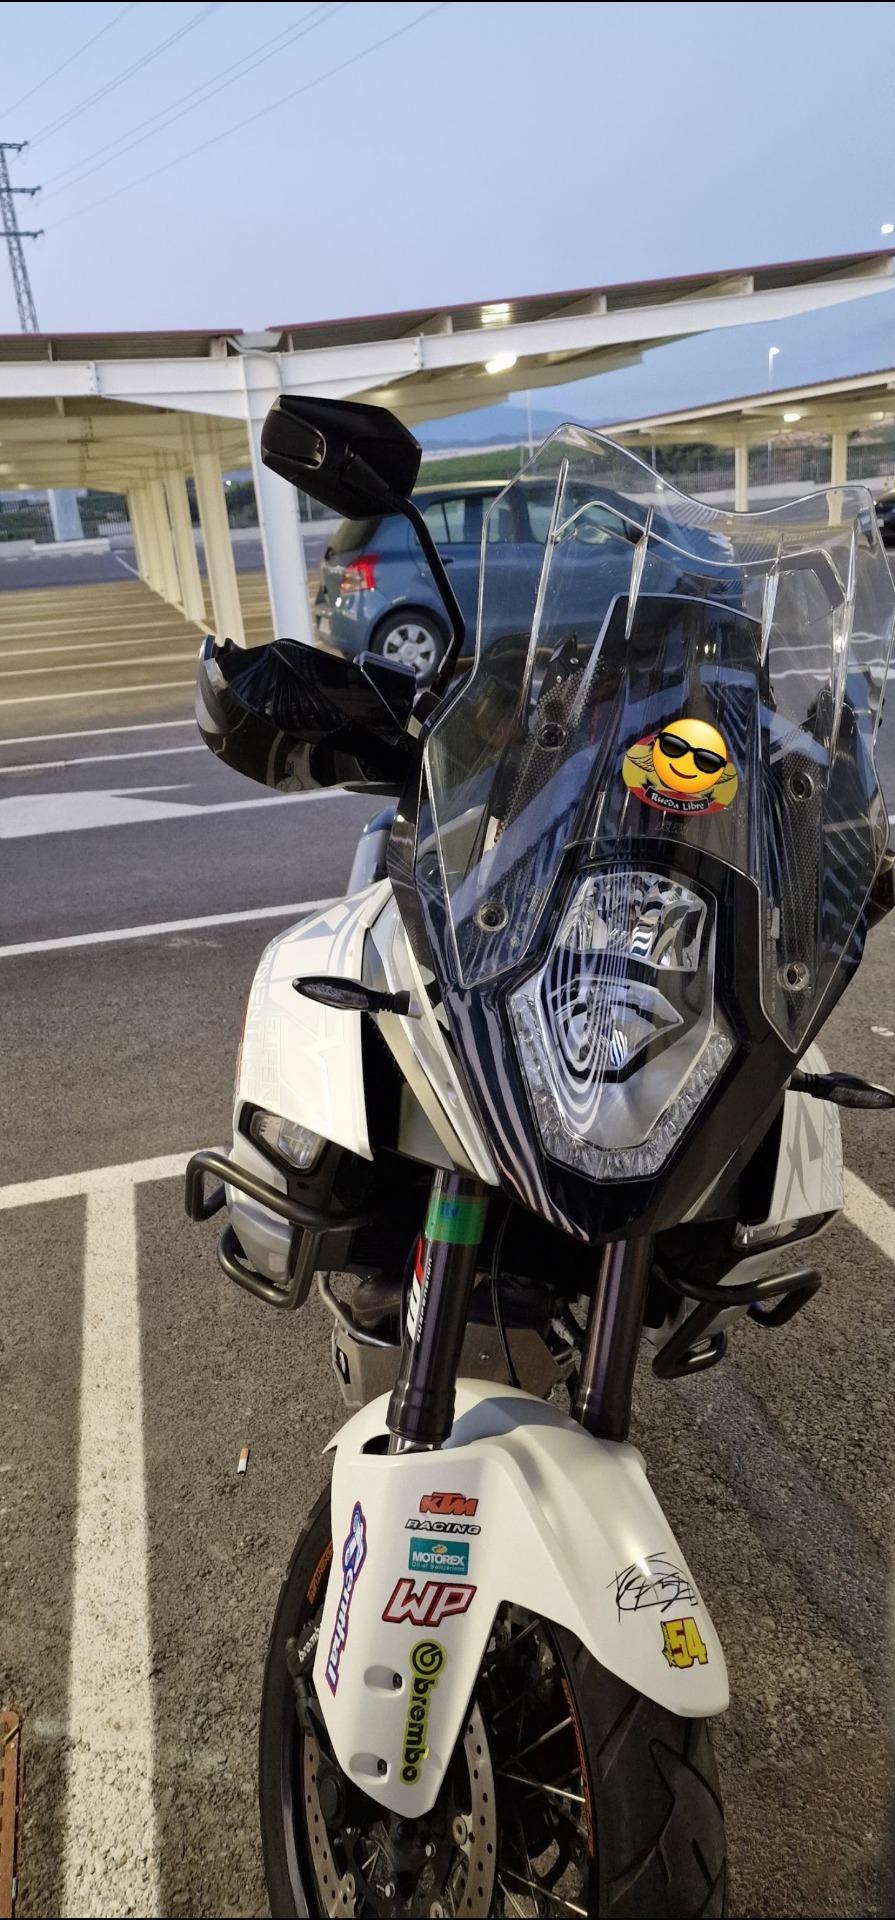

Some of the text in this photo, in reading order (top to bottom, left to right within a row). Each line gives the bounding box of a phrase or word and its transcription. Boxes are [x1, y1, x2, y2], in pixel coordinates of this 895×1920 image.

[682, 800, 705, 811] Libre
[420, 1492, 478, 1516] KTM
[405, 1519, 481, 1535] RACING
[412, 1551, 464, 1566] MOTOREX
[383, 1579, 476, 1625] WP
[660, 1617, 709, 1669] 54
[402, 1677, 435, 1783] brembo
